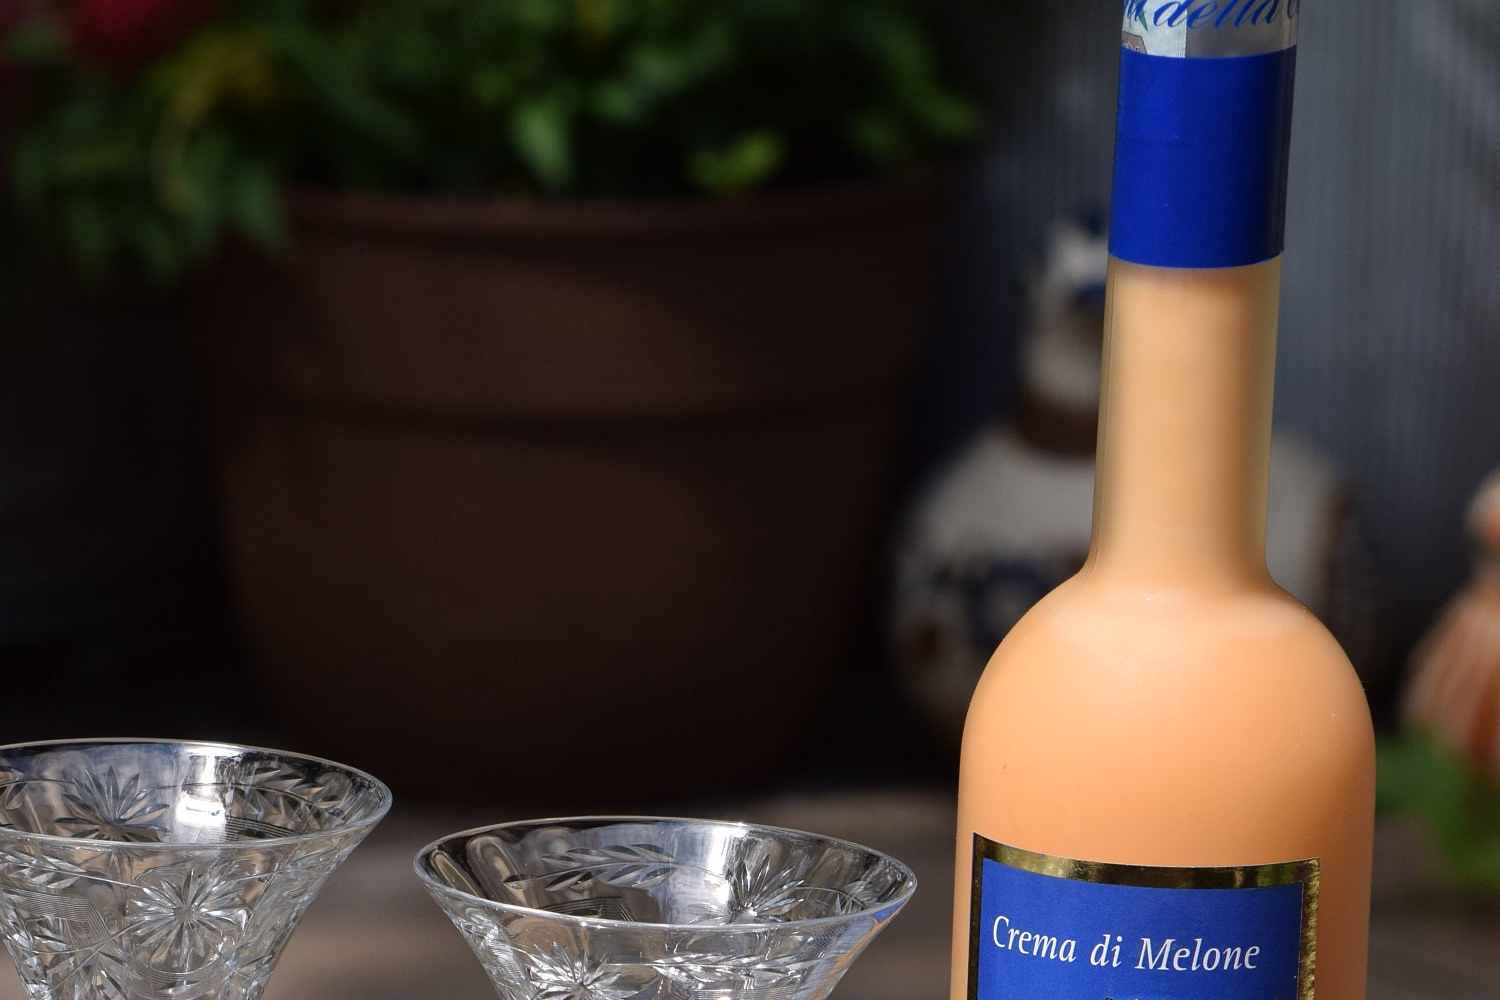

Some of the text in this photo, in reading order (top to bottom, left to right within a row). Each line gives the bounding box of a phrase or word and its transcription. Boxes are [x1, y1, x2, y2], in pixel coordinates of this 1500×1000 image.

[993, 915, 1260, 972] Crema di Melone
